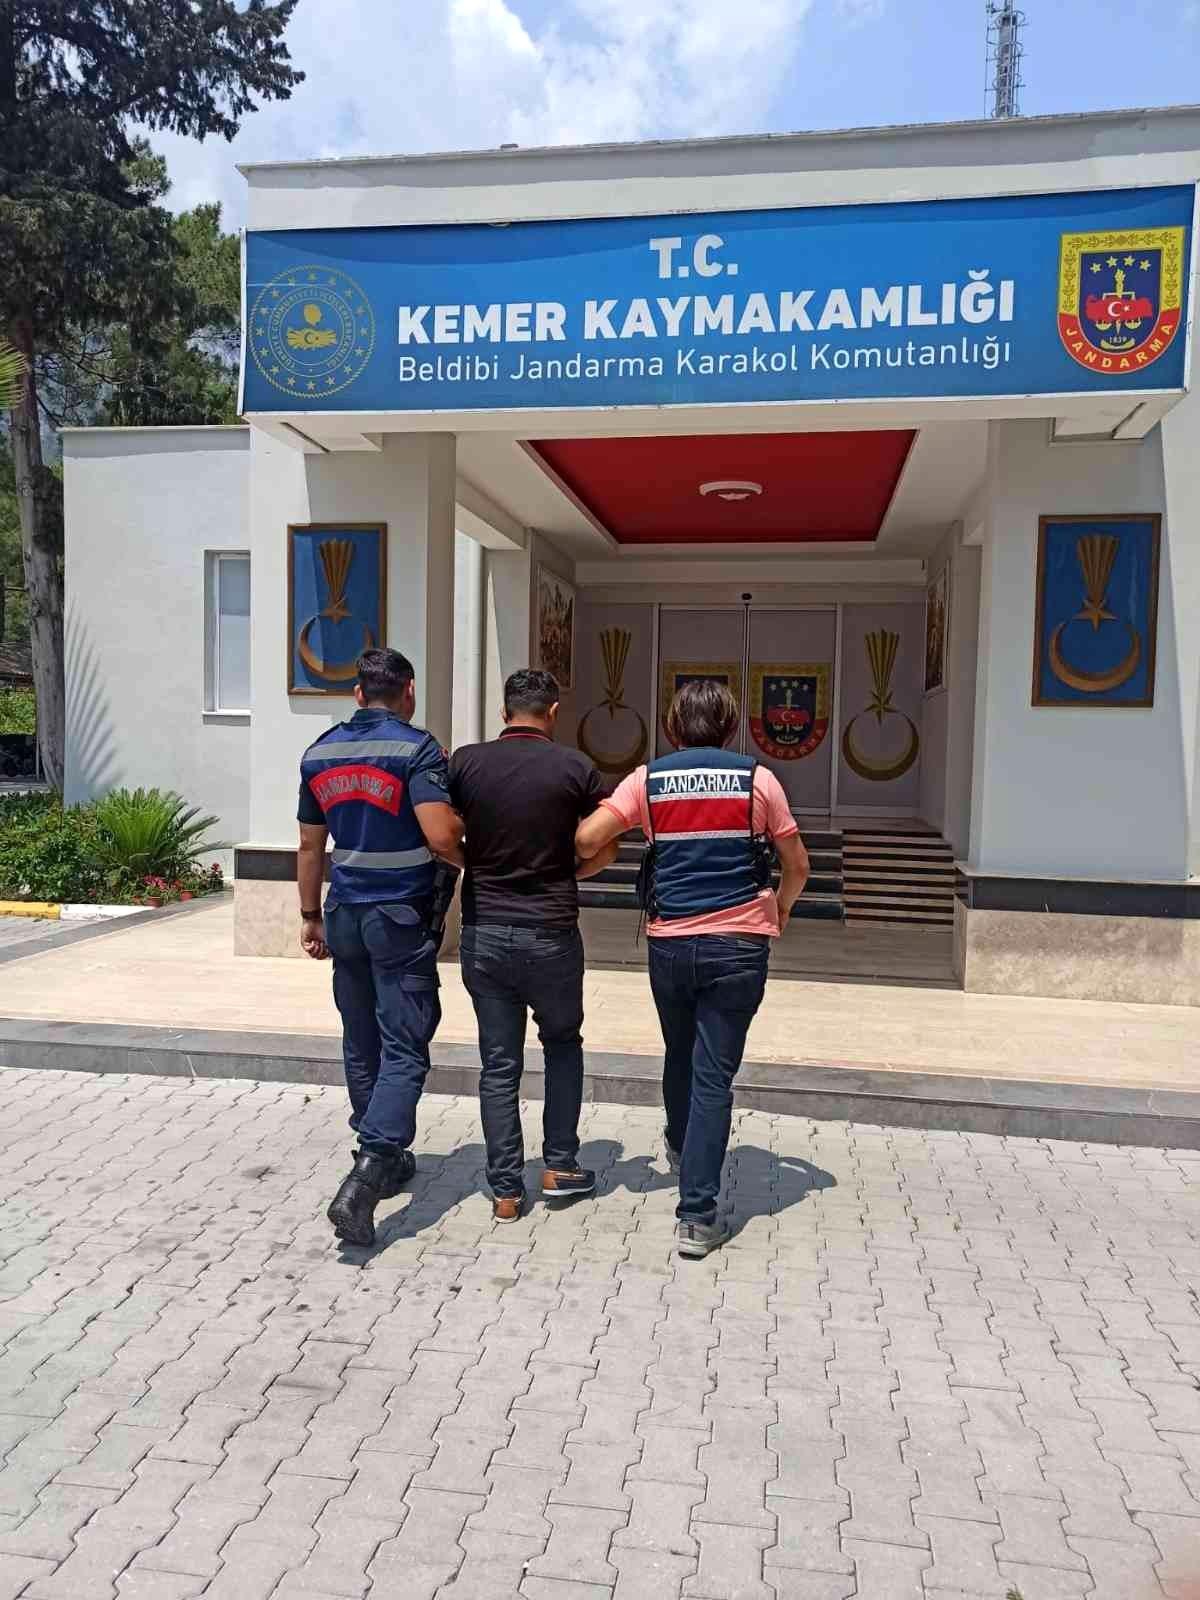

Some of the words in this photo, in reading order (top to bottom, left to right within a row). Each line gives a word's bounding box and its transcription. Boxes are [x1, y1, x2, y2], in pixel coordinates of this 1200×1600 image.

[648, 233, 738, 279] T.C.
[397, 301, 567, 345] KEMER
[583, 269, 1015, 340] KAYMAKAMLIĞI
[399, 354, 499, 382] Beldibi
[510, 352, 664, 380] Jandarma
[676, 343, 798, 375] Karakol
[810, 335, 1011, 371] Komutanlığı
[1065, 323, 1173, 369] JANDARMA
[317, 773, 395, 803] JANDARMA
[659, 774, 742, 793] JANDARMA
